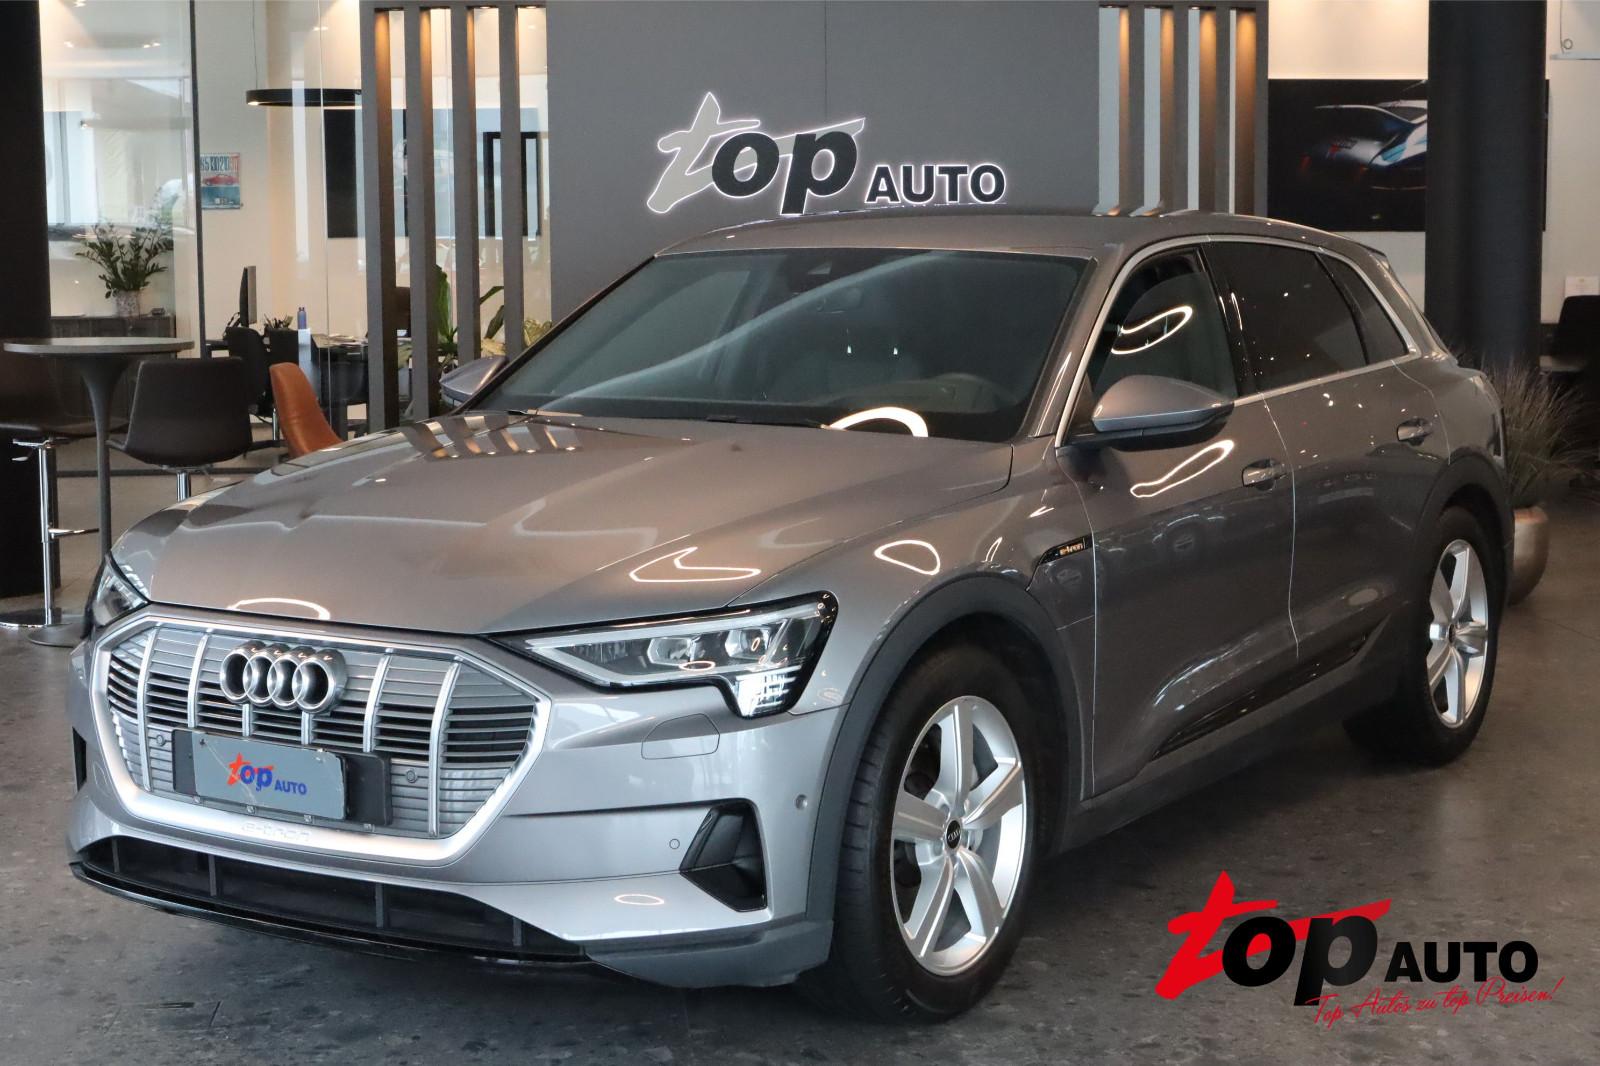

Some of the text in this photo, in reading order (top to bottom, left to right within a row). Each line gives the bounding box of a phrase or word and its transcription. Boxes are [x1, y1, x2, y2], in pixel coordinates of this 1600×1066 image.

[647, 92, 1006, 216] top AUTO
[227, 752, 307, 795] top AUTO
